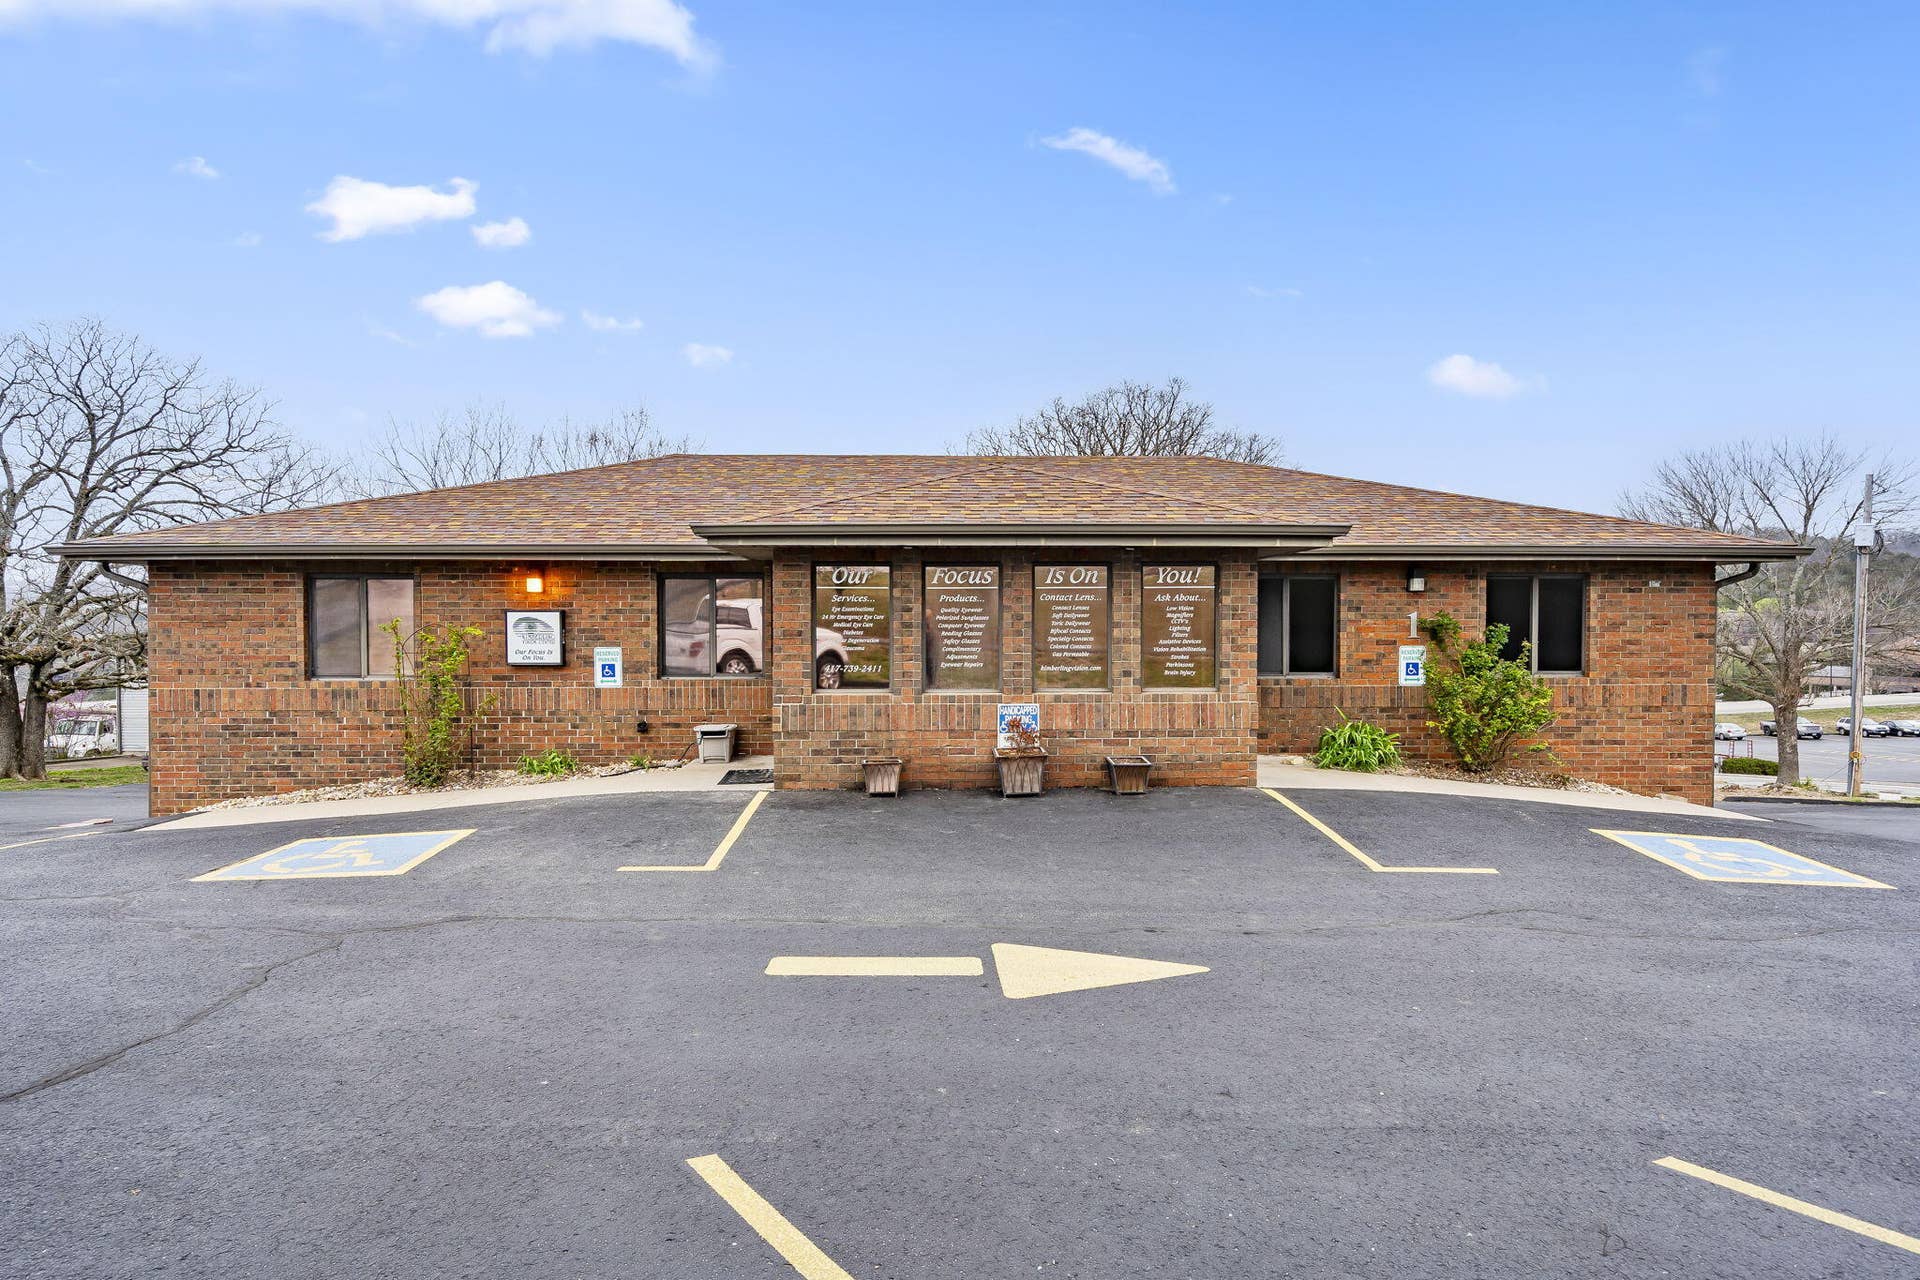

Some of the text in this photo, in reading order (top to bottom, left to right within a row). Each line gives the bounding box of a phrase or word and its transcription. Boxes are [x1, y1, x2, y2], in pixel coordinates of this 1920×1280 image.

[832, 567, 873, 584] Our
[931, 568, 993, 584] Focus
[1045, 568, 1098, 584] Is On
[1157, 567, 1202, 583] You!
[832, 594, 875, 602] Services...
[1000, 706, 1038, 715] HANDICAPPED
